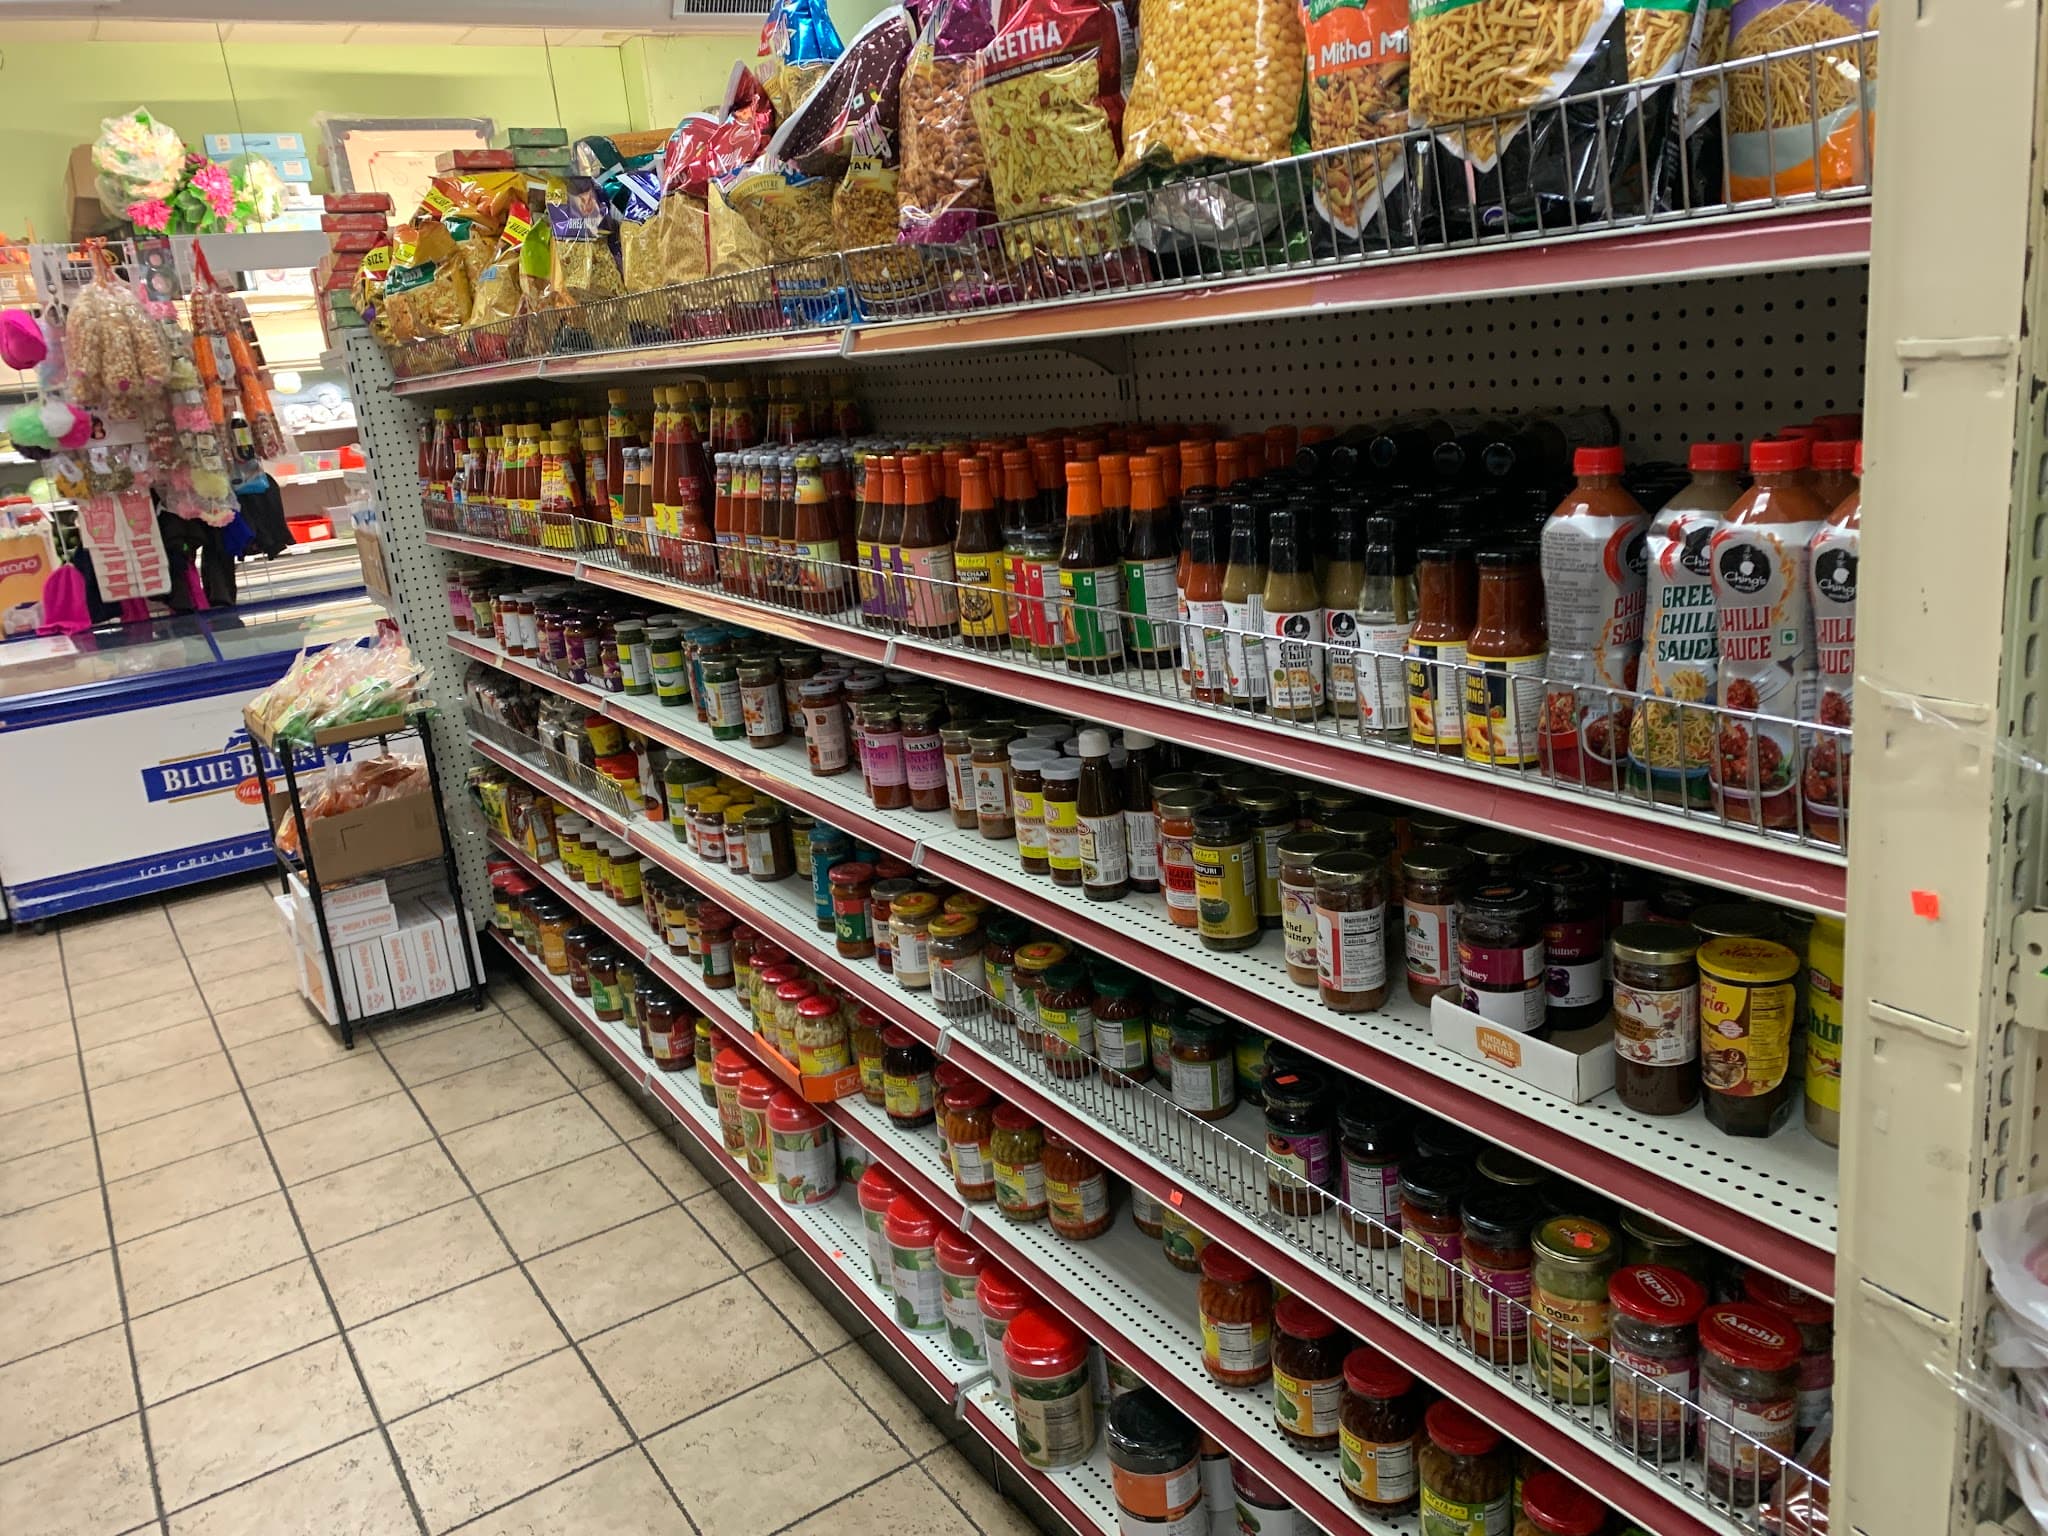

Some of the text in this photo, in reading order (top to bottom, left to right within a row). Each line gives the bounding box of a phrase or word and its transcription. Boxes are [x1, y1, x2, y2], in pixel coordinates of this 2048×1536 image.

[983, 21, 1062, 67] MEETHA
[1321, 39, 1372, 68] Mitha
[1380, 29, 1408, 56] Mi
[367, 251, 385, 267] SIZE
[1724, 571, 1766, 587] Ching's
[1818, 577, 1857, 595] Ching
[1613, 589, 1645, 620] CHIL
[1662, 584, 1718, 609] GREE
[1611, 614, 1644, 646] SAU
[1661, 610, 1718, 635] CHILL
[1720, 606, 1770, 632] HILLI
[1280, 641, 1312, 651] Gre
[1720, 635, 1772, 661] AUCE
[161, 760, 235, 793] BLUE
[139, 864, 168, 879] ICE
[177, 849, 235, 871] CREAM
[1285, 931, 1313, 945] utney
[1286, 920, 1302, 934] Bhel
[1548, 946, 1581, 959] hutney
[1481, 1039, 1515, 1058] NATURE
[1731, 1053, 1740, 1065] 9
[1640, 1272, 1678, 1304] Aachi
[1541, 1304, 1580, 1323] TOOBA
[1722, 1316, 1779, 1344] Aachi
[1628, 1354, 1667, 1376] Aachi
